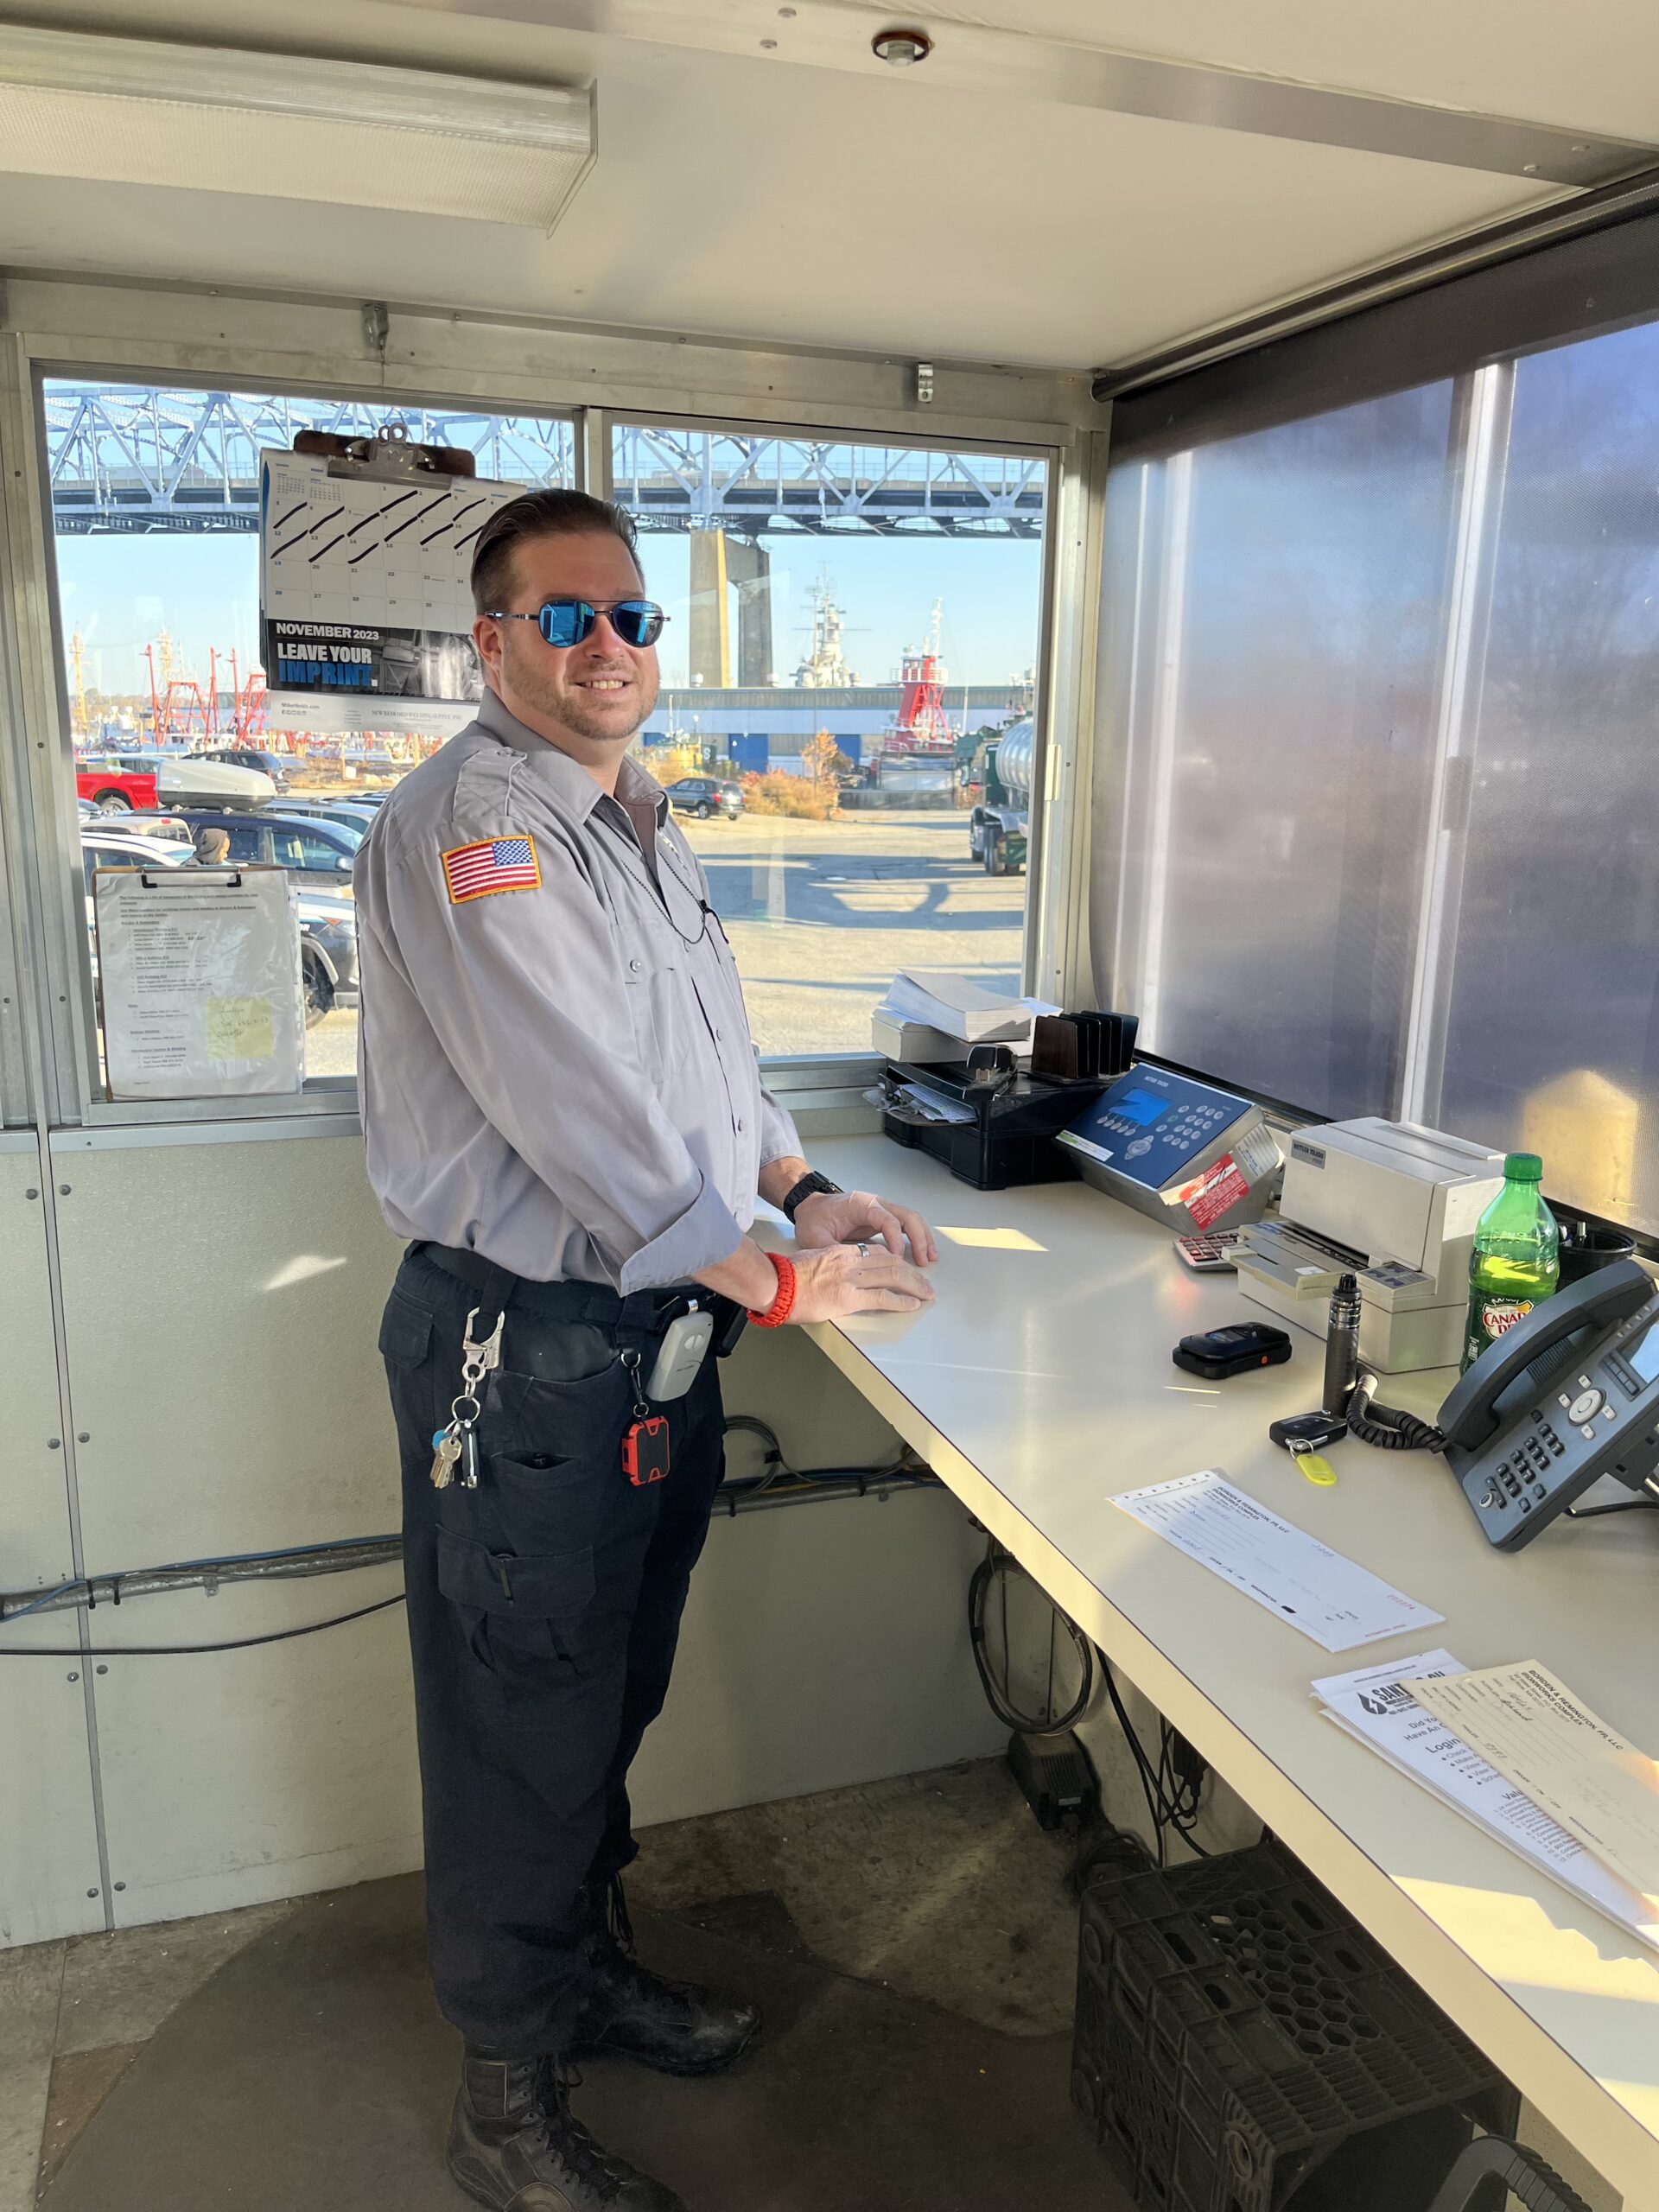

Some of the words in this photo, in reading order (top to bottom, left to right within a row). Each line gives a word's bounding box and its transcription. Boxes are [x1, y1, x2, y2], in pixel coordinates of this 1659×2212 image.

[276, 622, 352, 639] NOVEMBER
[353, 629, 379, 640] 2023
[277, 642, 328, 662] LEAVE
[329, 645, 372, 664] YOUR
[278, 659, 378, 687] IMPRINT.
[1372, 1682, 1411, 1700] SANT
[1521, 1671, 1556, 1702] IRONWORKS
[1554, 1702, 1584, 1726] COMPLEX
[1529, 1669, 1556, 1692] BORDEN
[1607, 1738, 1624, 1751] LLC
[1408, 1720, 1425, 1729] Did
[1403, 1730, 1427, 1741] Have
[1425, 1738, 1461, 1753] Login
[1501, 1789, 1524, 1800] Valu
